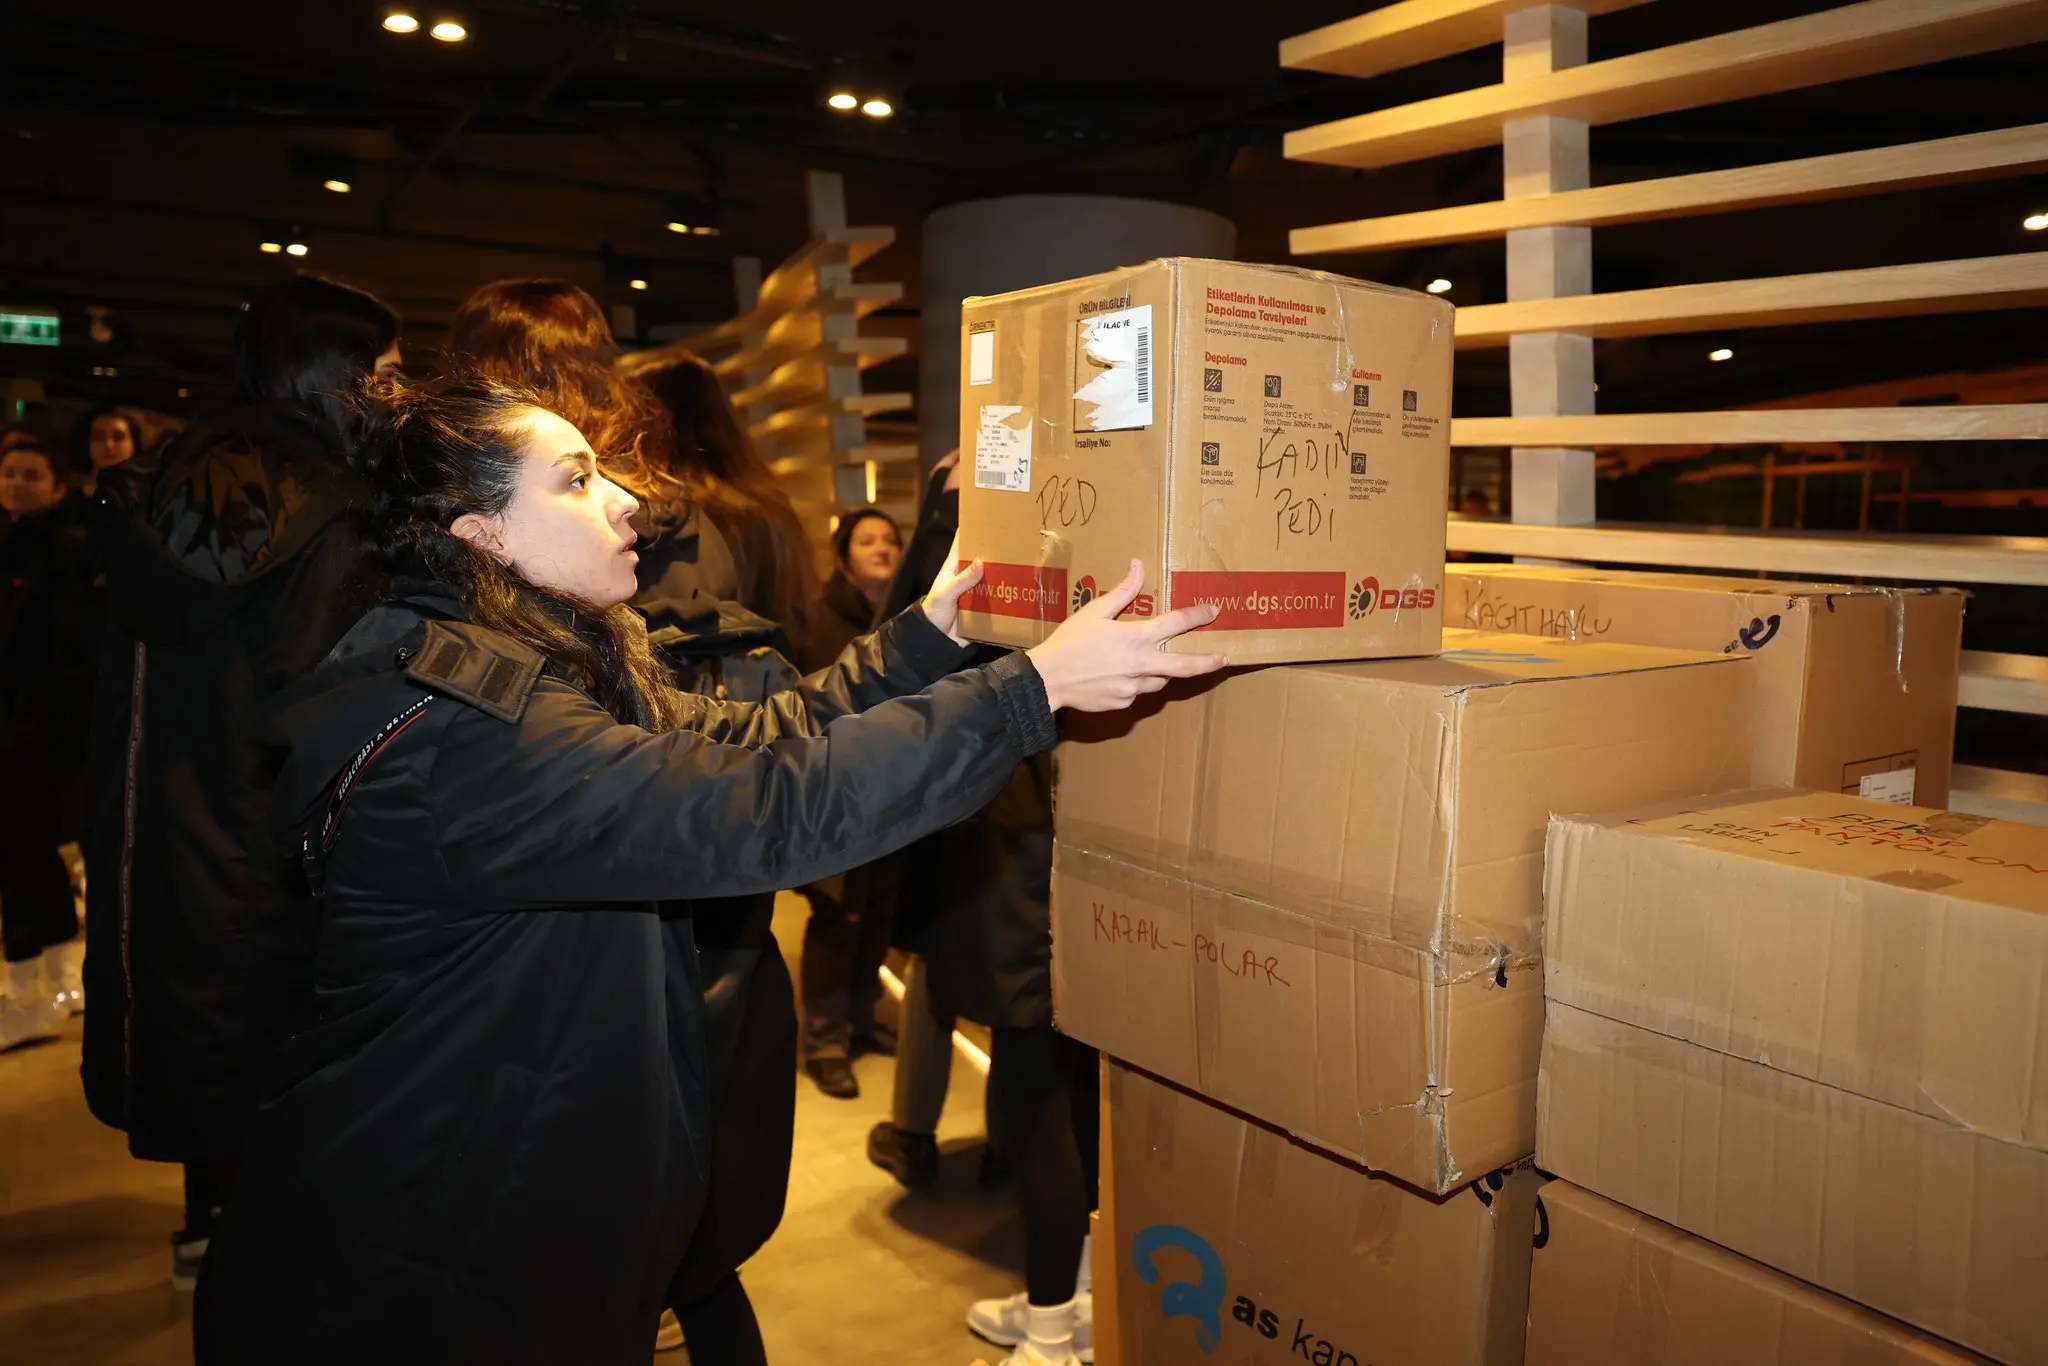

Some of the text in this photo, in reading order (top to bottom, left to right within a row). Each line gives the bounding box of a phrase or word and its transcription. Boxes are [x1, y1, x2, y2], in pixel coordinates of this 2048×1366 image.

[1206, 287, 1326, 315] Etiketlerin Kullanılması ve
[1206, 302, 1307, 327] Depolama Tavsiyeleri
[1205, 351, 1248, 367] Depolama
[1352, 369, 1382, 382] Kullanım
[1099, 437, 1111, 448] No:
[1380, 588, 1435, 609] DGS
[1540, 604, 1612, 636] HAVLU
[1713, 822, 1780, 838] GTIN
[1232, 1295, 1280, 1340] as
